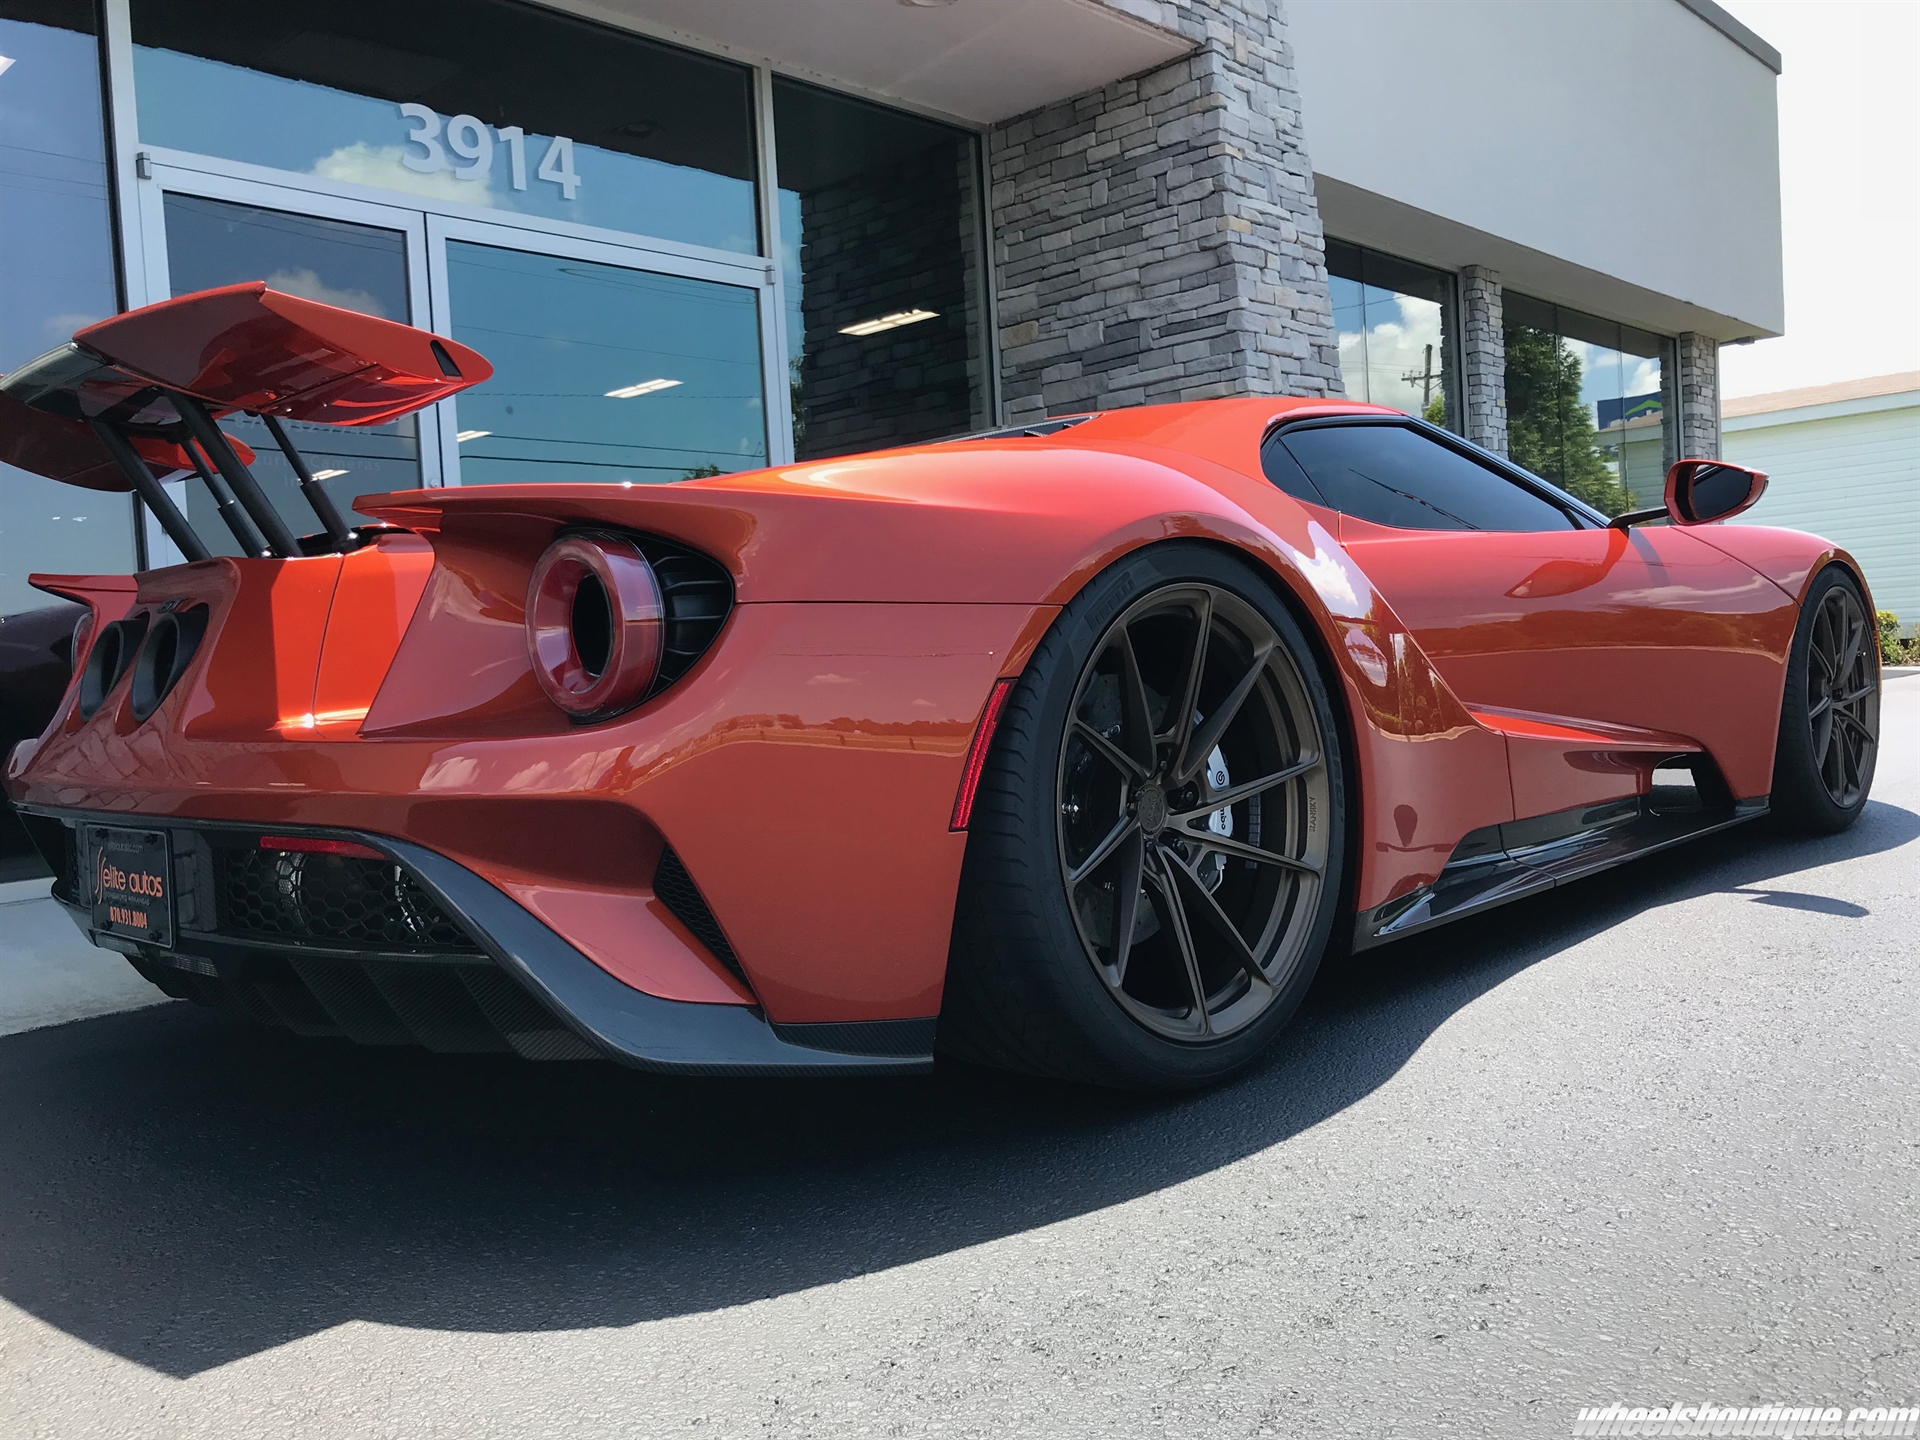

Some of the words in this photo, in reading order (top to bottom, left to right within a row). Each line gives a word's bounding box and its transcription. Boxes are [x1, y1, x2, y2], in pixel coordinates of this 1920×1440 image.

[400, 102, 582, 200] 3914
[310, 454, 382, 472] Cameras
[103, 864, 126, 891] elite
[129, 870, 163, 898] autos
